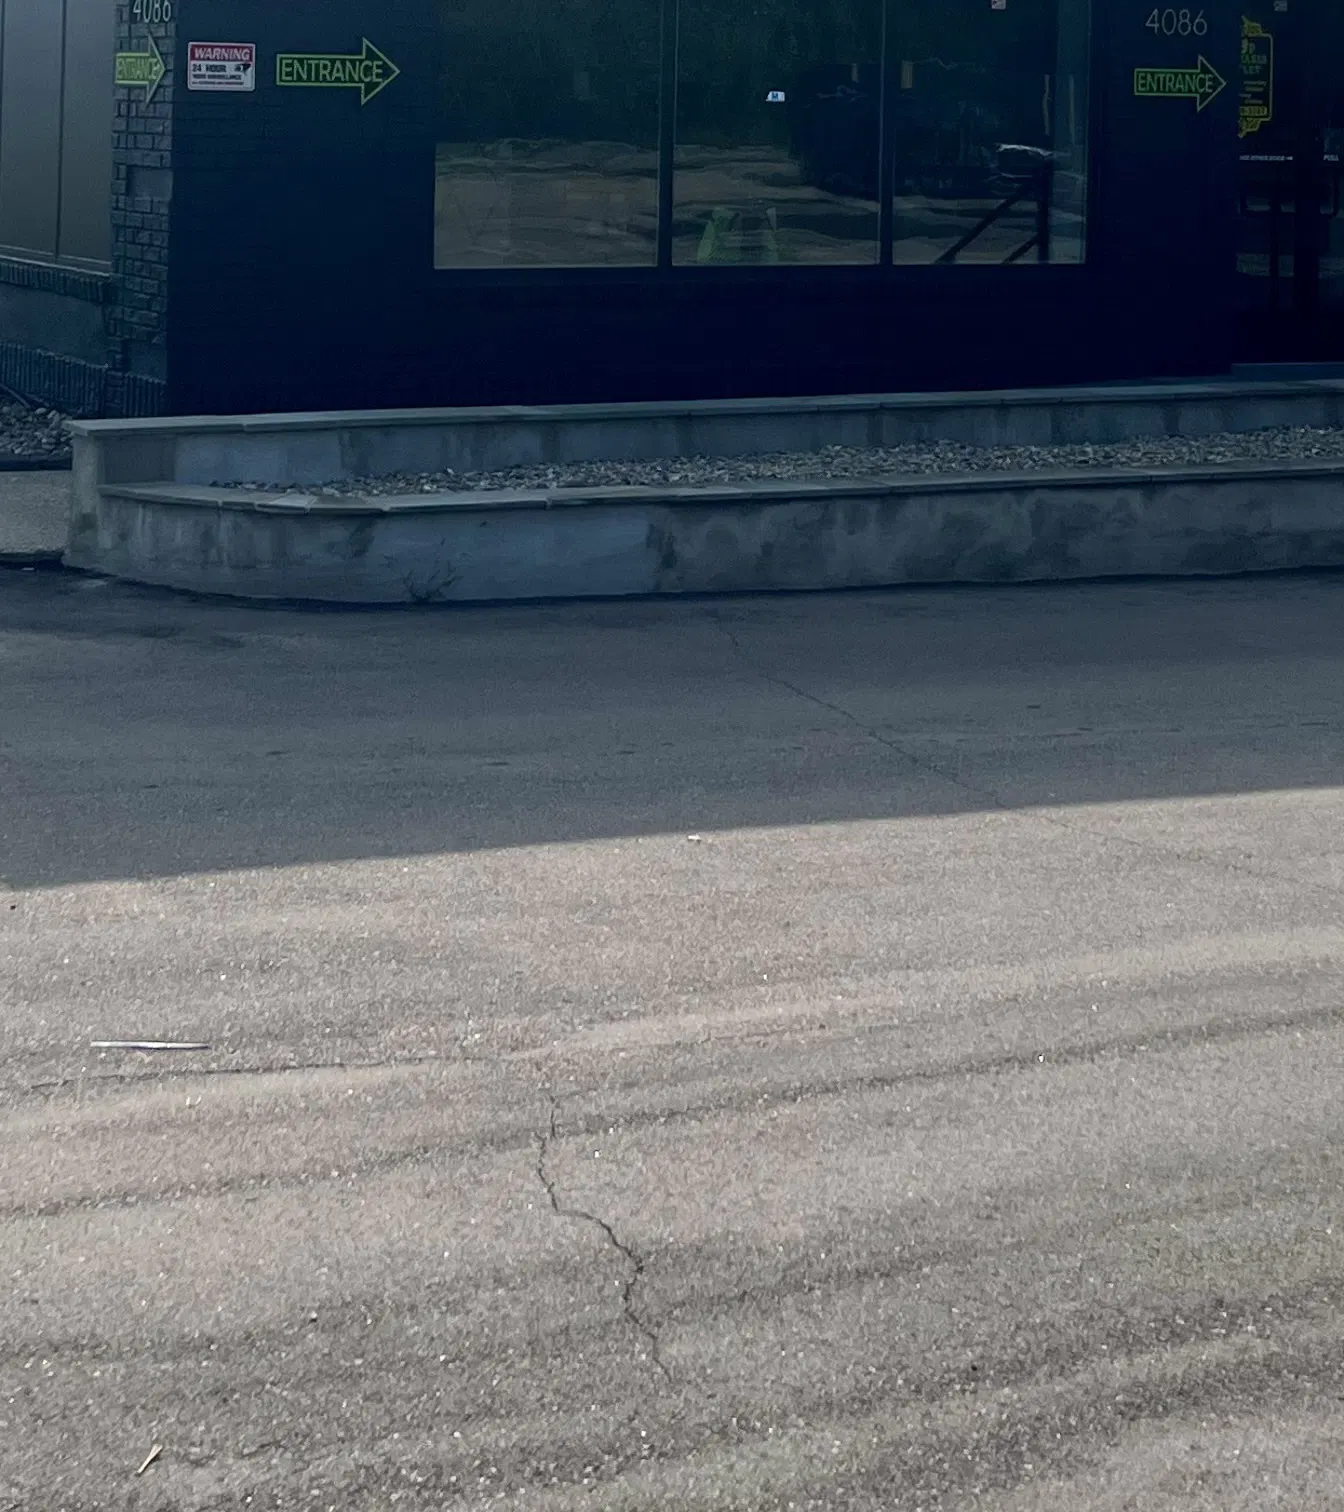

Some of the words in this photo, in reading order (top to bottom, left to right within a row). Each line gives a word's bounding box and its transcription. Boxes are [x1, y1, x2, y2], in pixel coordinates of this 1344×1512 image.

[1145, 8, 1208, 36] 4086
[194, 46, 251, 61] WARNING
[281, 60, 384, 83] ENTRANCE
[1137, 72, 1214, 93] ENTRANCE
